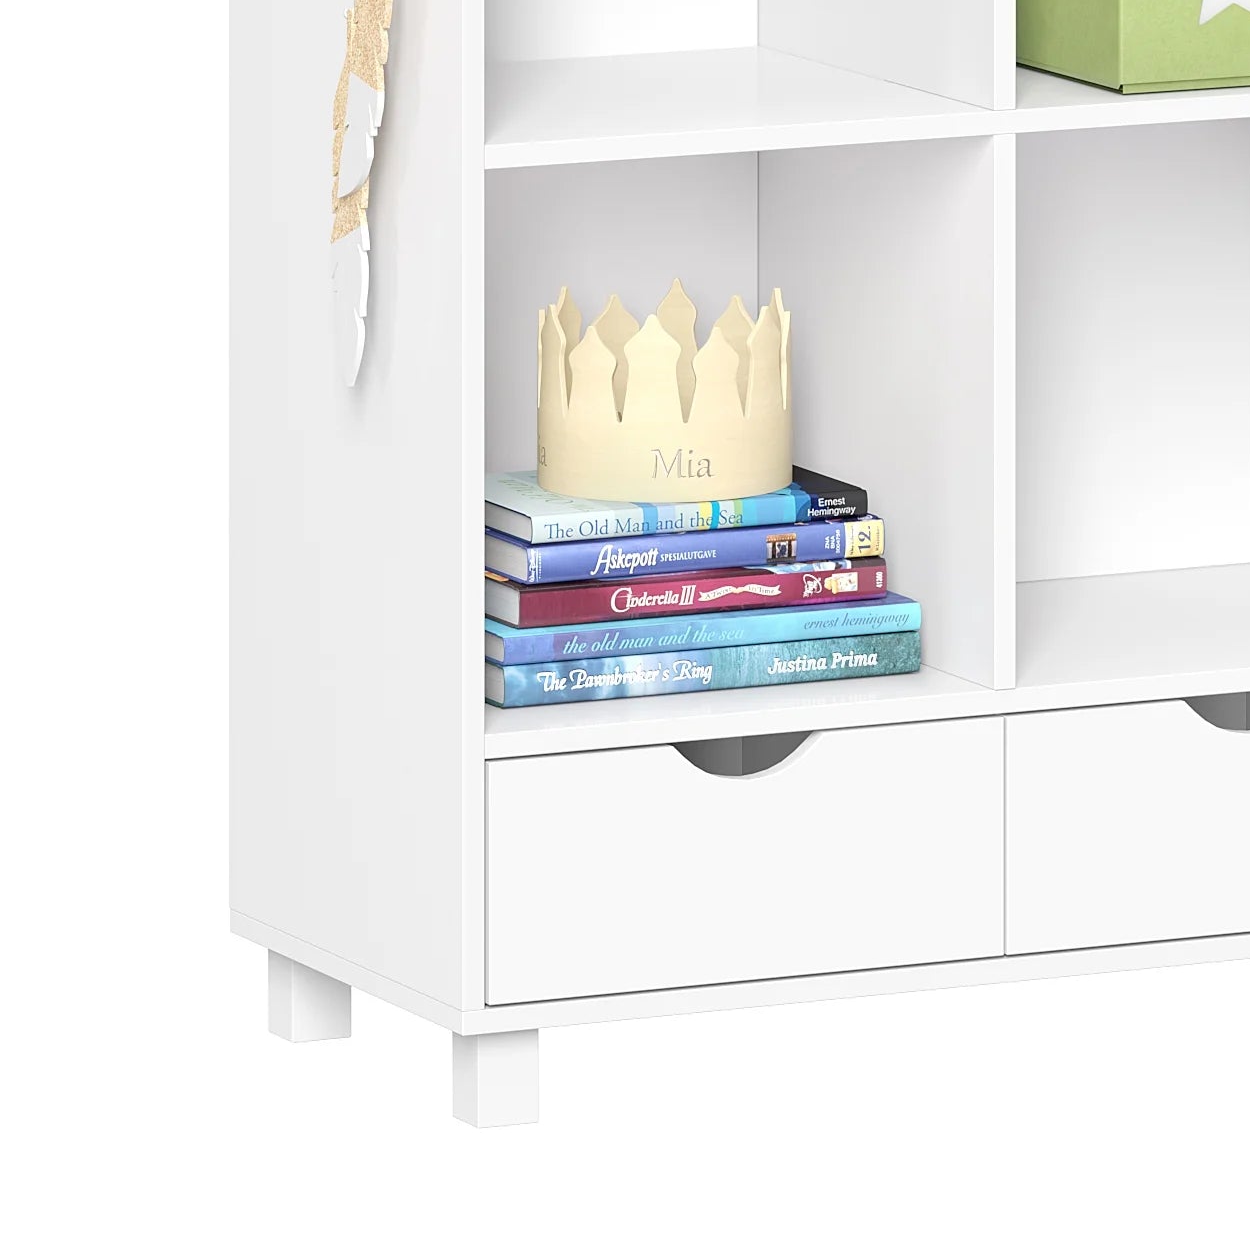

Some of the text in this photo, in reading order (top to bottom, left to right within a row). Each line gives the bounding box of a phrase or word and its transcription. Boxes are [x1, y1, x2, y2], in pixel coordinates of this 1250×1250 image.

[651, 448, 716, 478] Mia
[807, 506, 856, 517] Hemingway
[818, 497, 846, 508] Ernest
[544, 510, 743, 540] The Old Man and the Sea
[590, 545, 717, 575] Askepott SPESIALUTGAVE
[611, 585, 696, 613] Cinderella III
[804, 612, 910, 630] ernest hemingway
[563, 624, 744, 654] the old man and the sea
[537, 660, 713, 692] The Pawnbroker's Ring
[768, 651, 878, 675] Justina Prima
